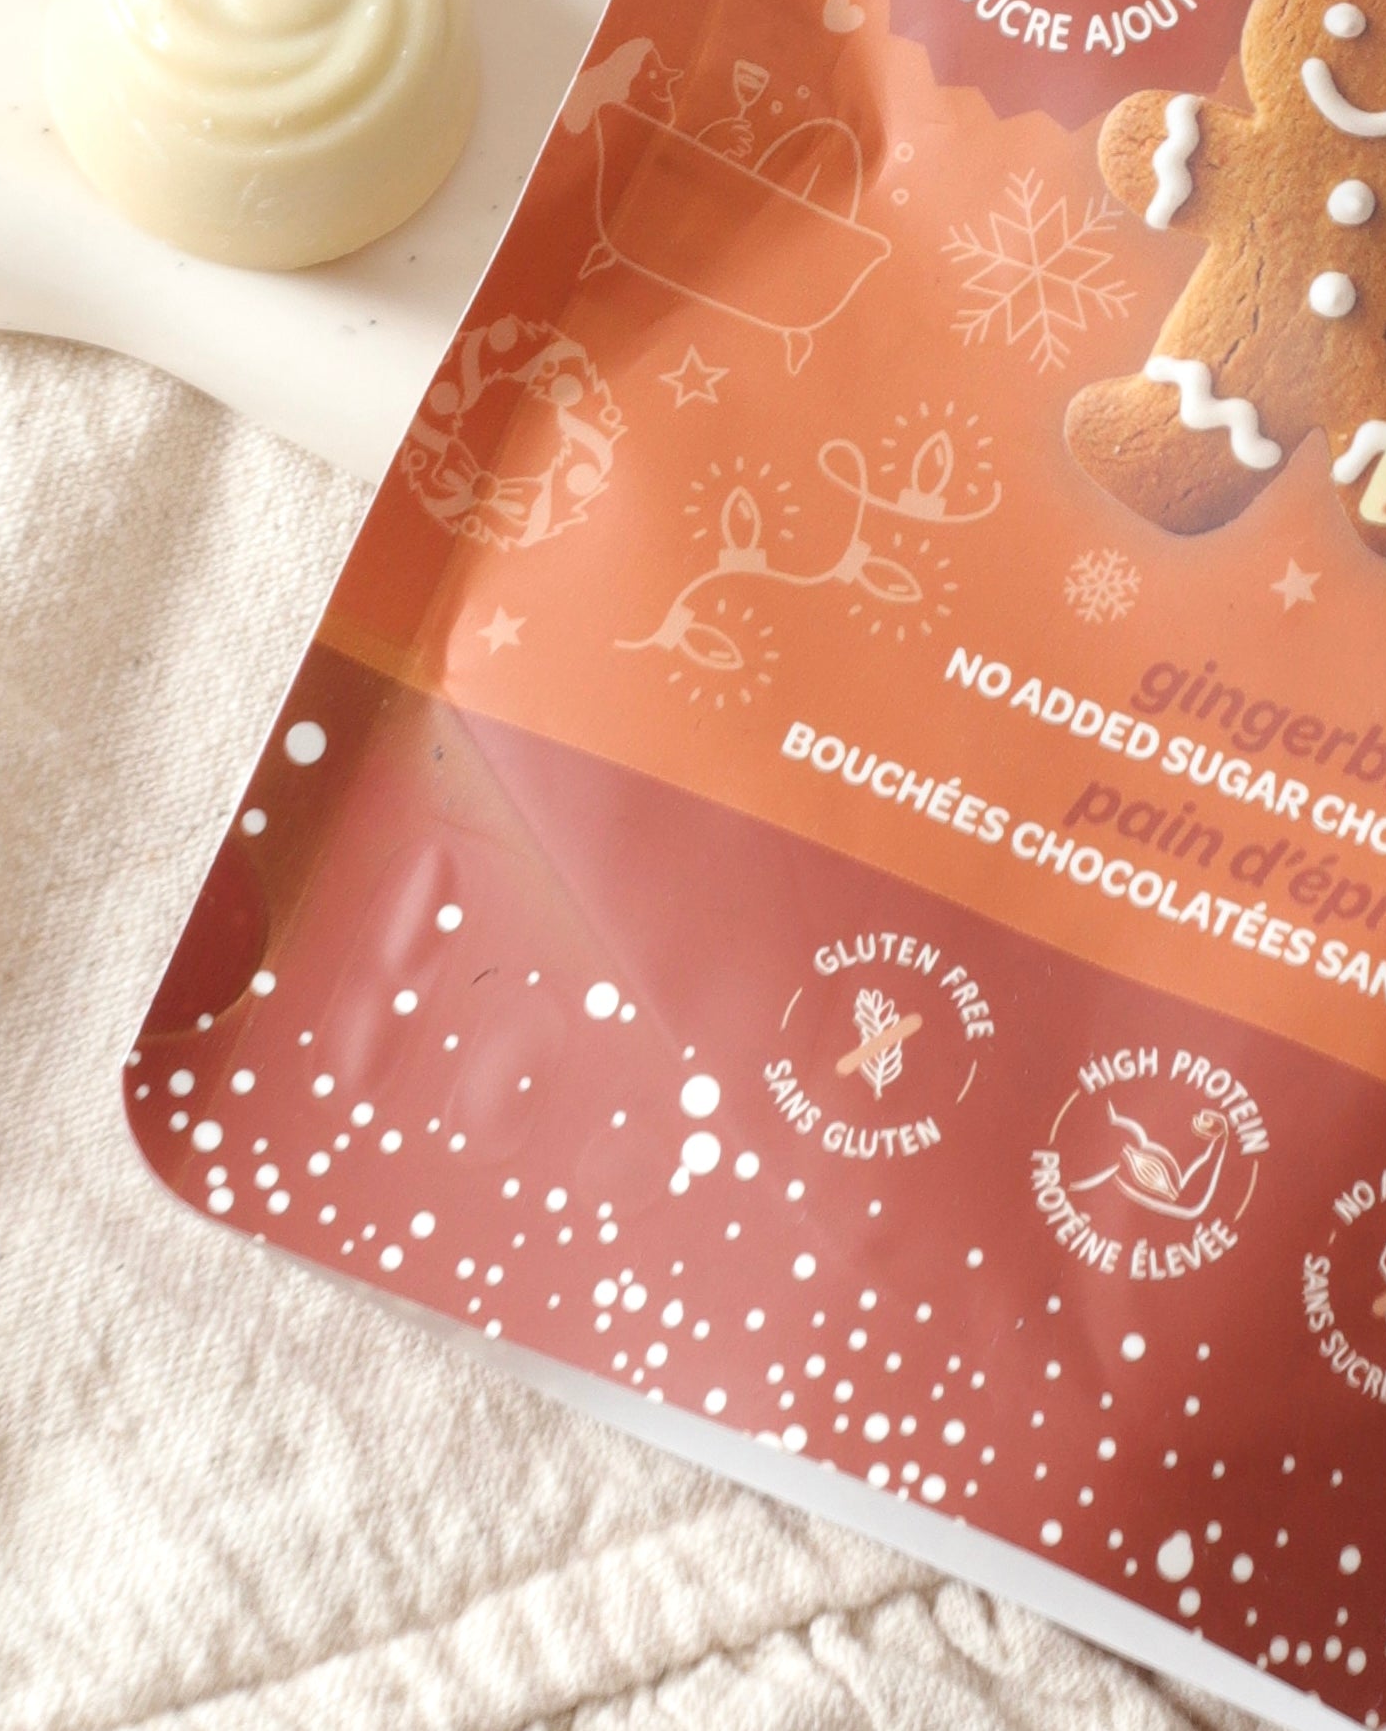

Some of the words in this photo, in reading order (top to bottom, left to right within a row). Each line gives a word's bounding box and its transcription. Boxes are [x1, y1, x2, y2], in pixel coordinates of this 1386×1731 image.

[944, 647, 1012, 699] NO
[1009, 677, 1160, 761] ADDED
[1161, 735, 1310, 821] SUGAR
[780, 721, 1011, 844] BOUCHÉES
[1011, 822, 1316, 966] CHOCOLATÉES
[1062, 779, 1224, 869] pain
[813, 932, 941, 976] GLUTEN
[938, 965, 995, 1041] FREE
[763, 1059, 822, 1135] SANS
[822, 1116, 941, 1159] GLUTEN
[1077, 1047, 1158, 1095] HIGH
[1170, 1049, 1270, 1156] PROTEIN
[1030, 1149, 1122, 1273] PROTÉINE
[1129, 1217, 1238, 1280] ÉLEVÉE
[1332, 1179, 1376, 1225] NO
[1302, 1252, 1334, 1333] SANS
